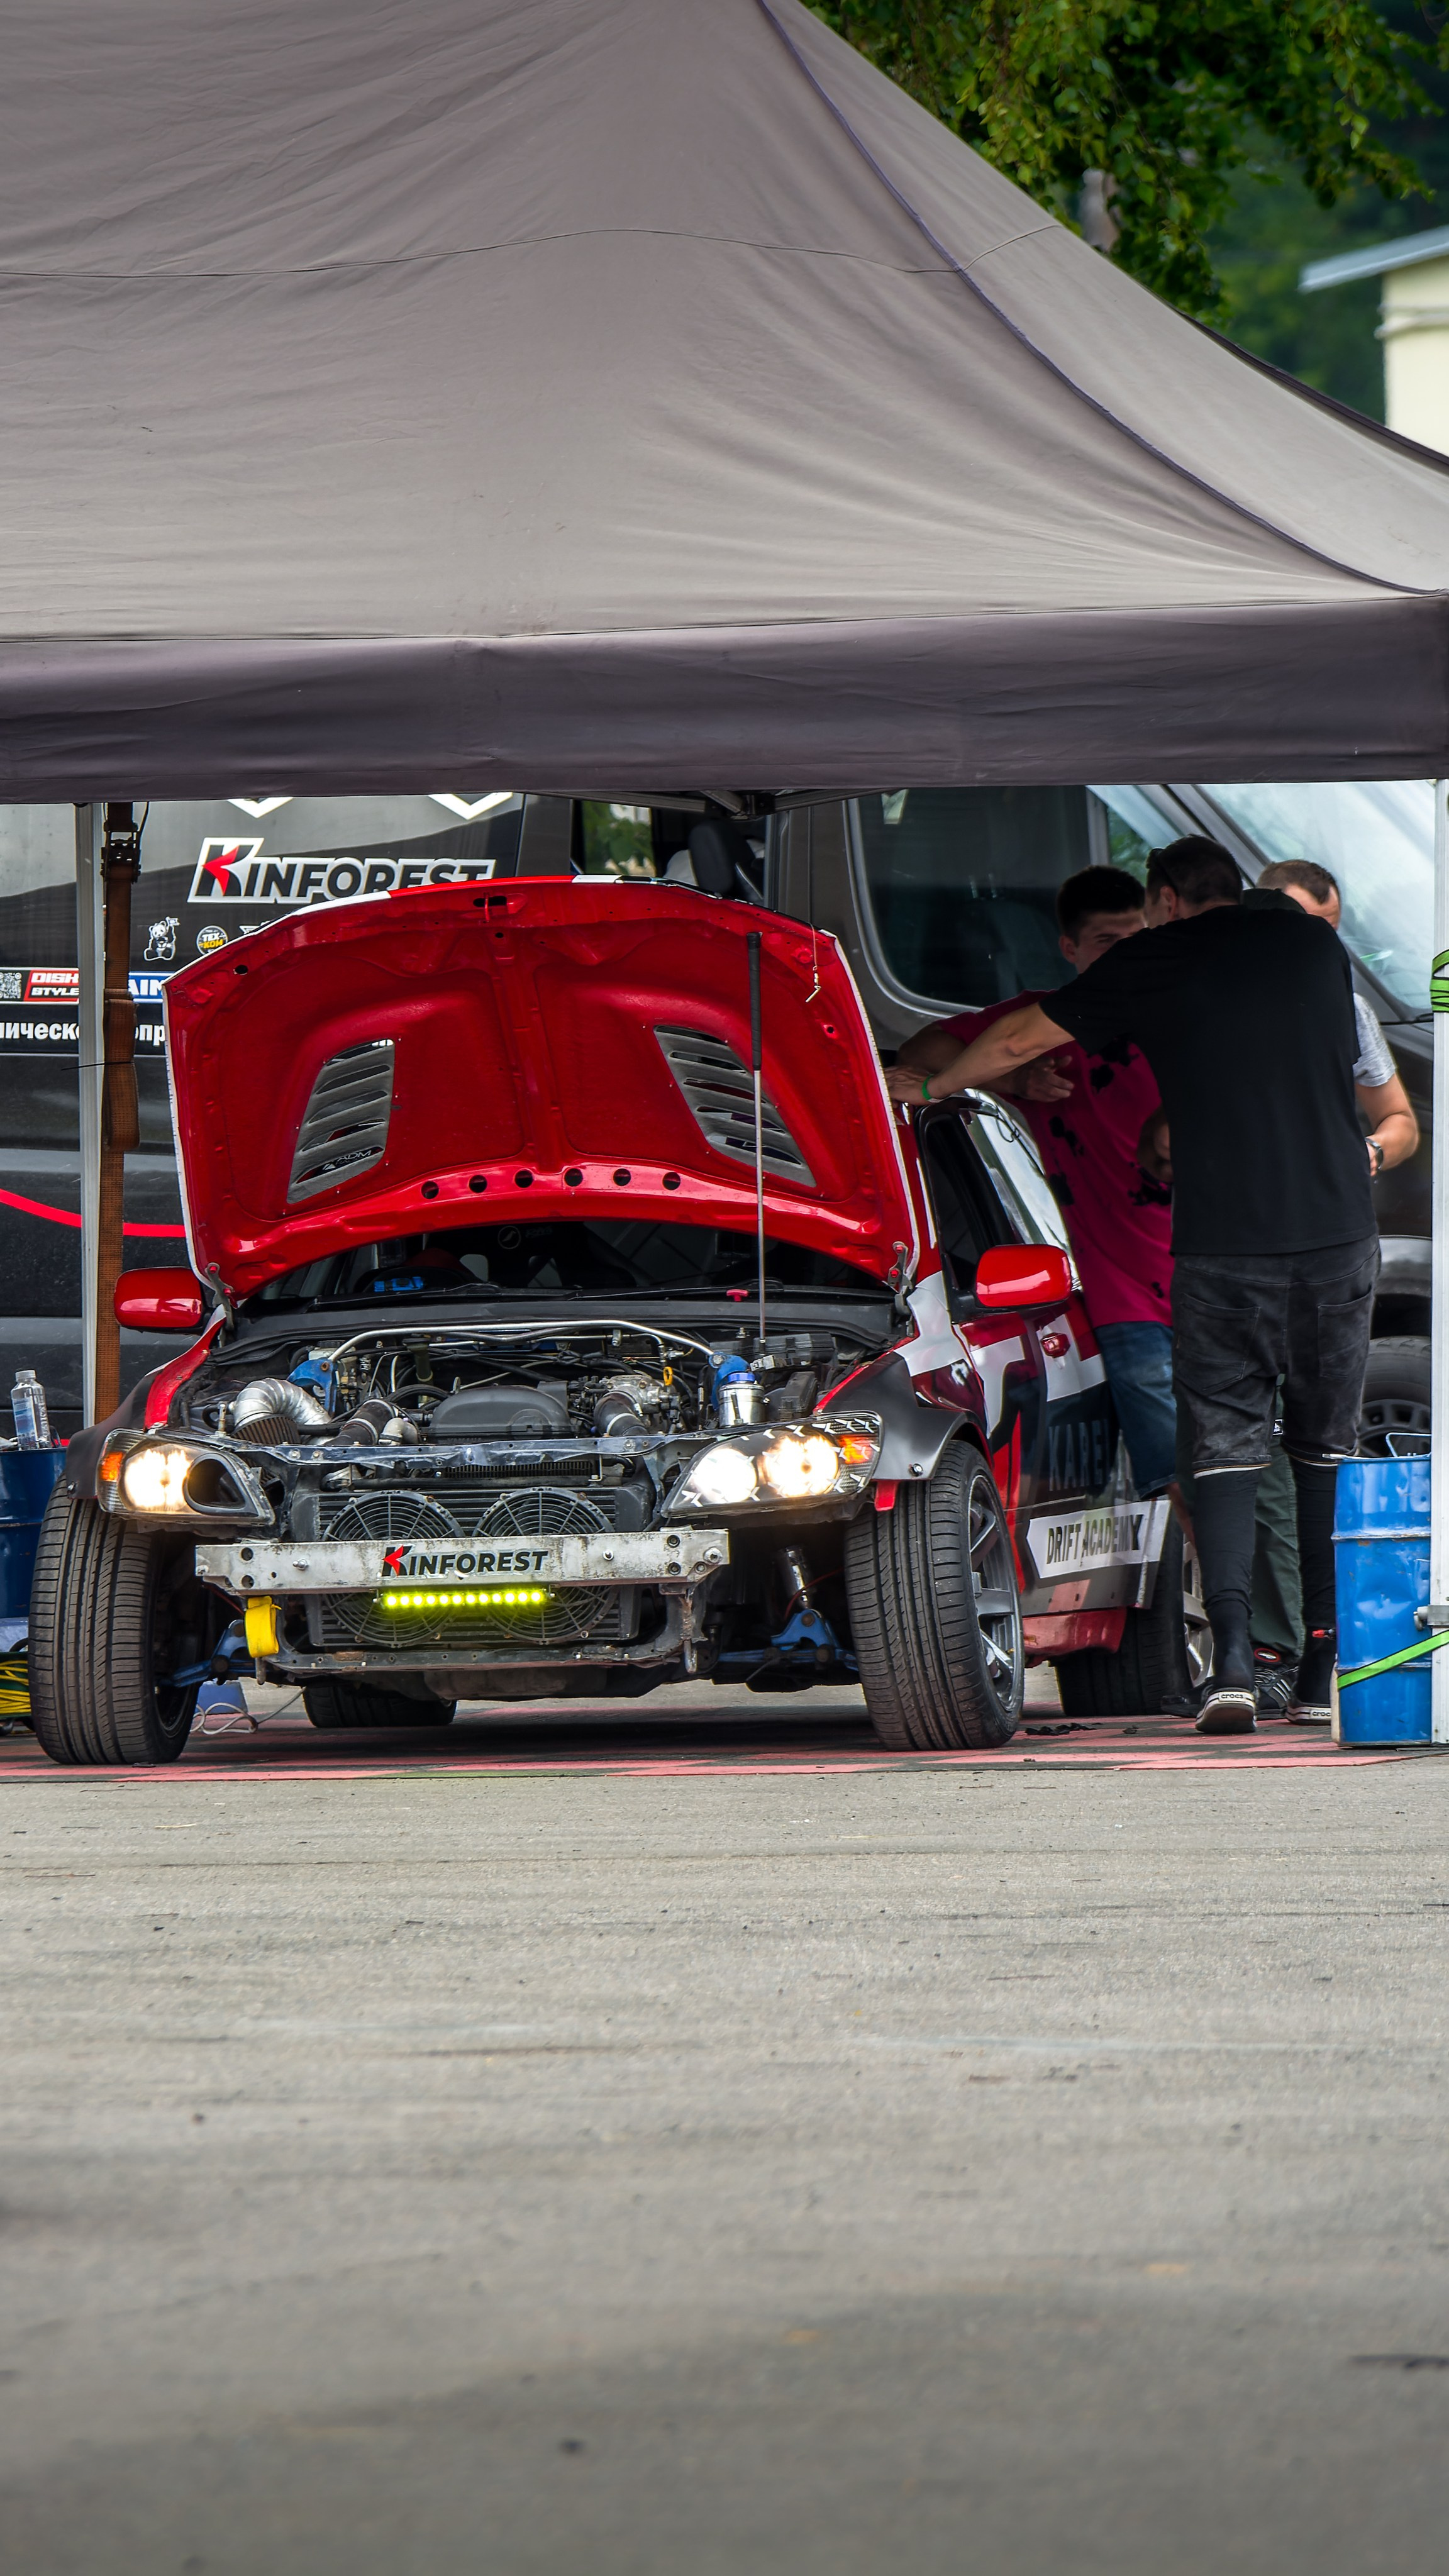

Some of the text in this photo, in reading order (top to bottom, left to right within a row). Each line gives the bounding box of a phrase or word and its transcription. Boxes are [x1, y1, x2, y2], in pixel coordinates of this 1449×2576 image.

[31, 987, 79, 996] STYLE
[1046, 1514, 1144, 1564] DRIFT ACADEMY
[382, 1545, 548, 1577] KINFOREST
